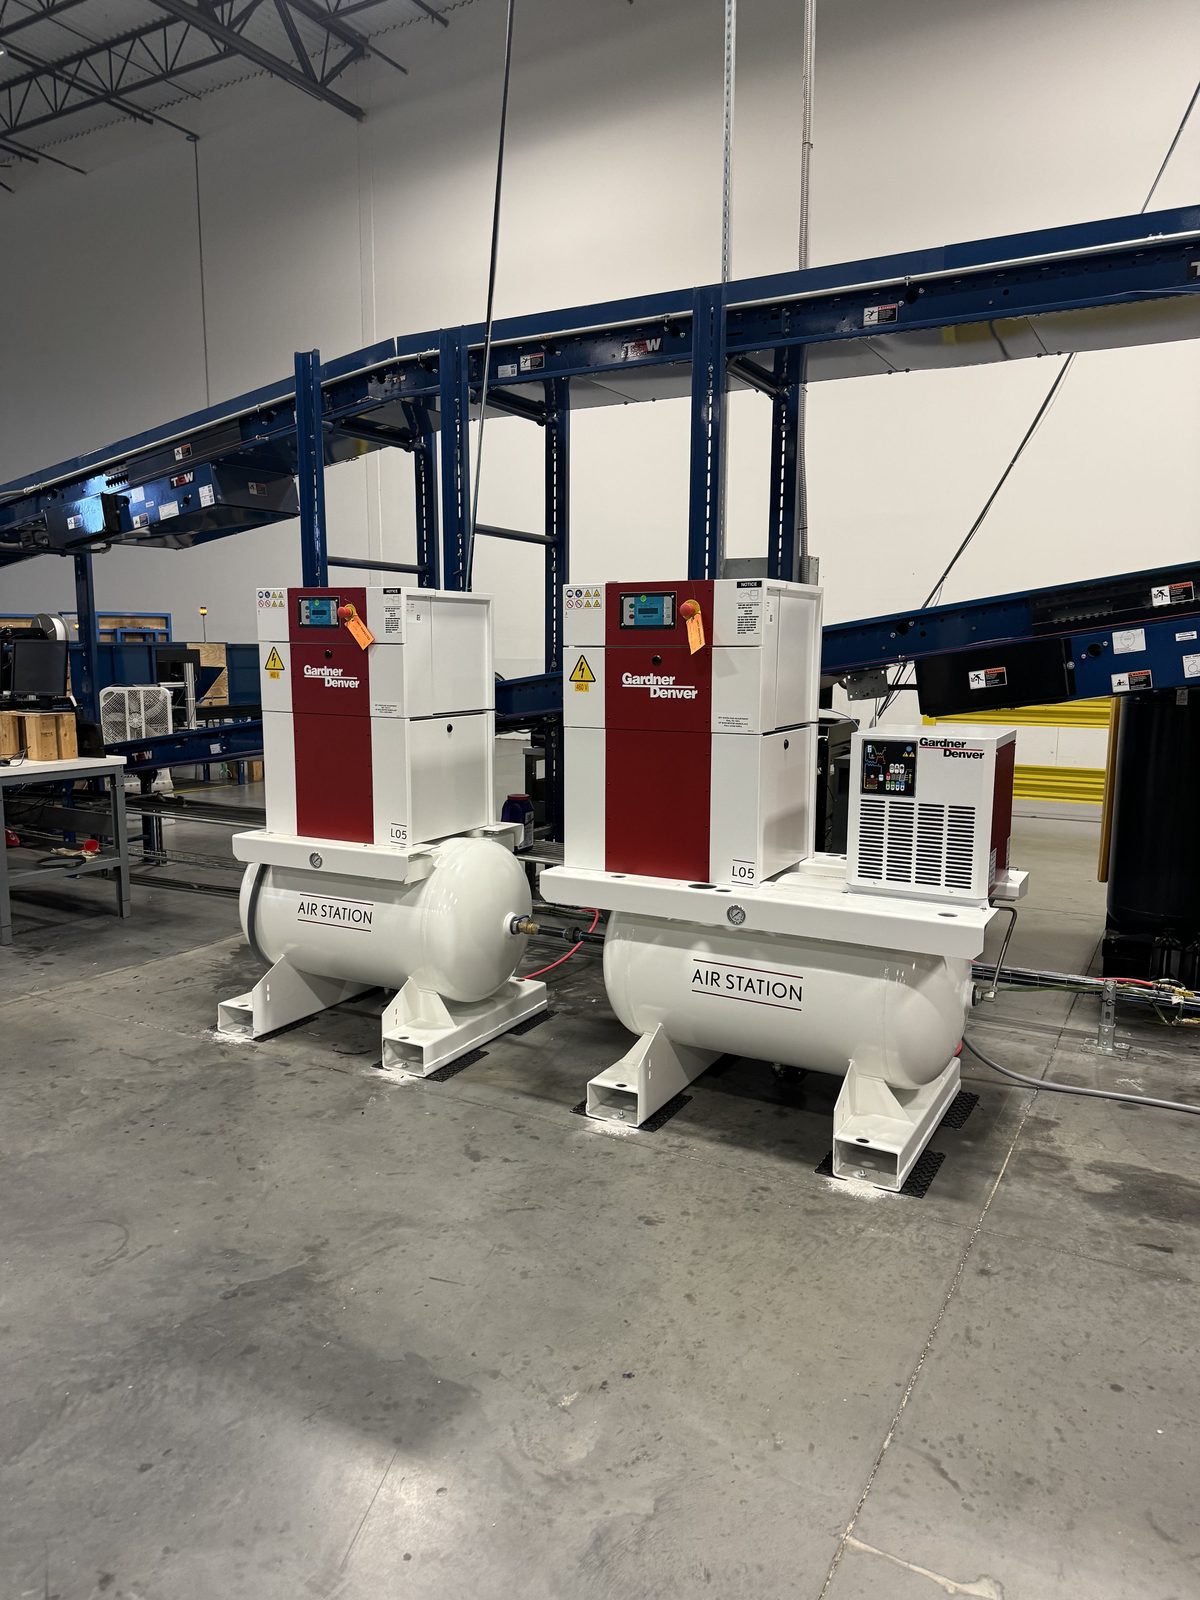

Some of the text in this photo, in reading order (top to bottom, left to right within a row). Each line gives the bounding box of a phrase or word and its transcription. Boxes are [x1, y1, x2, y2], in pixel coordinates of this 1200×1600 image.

[170, 471, 193, 487] TGW
[304, 665, 343, 676] Gardner
[324, 677, 360, 688] Denver
[622, 672, 675, 686] Gardner
[650, 686, 698, 700] Denver
[919, 737, 967, 749] Gardner
[943, 749, 985, 760] Denver
[391, 828, 407, 839] L05
[731, 865, 755, 879] L05
[298, 902, 372, 924] AIR STATION
[692, 969, 803, 1002] AIR STATION
